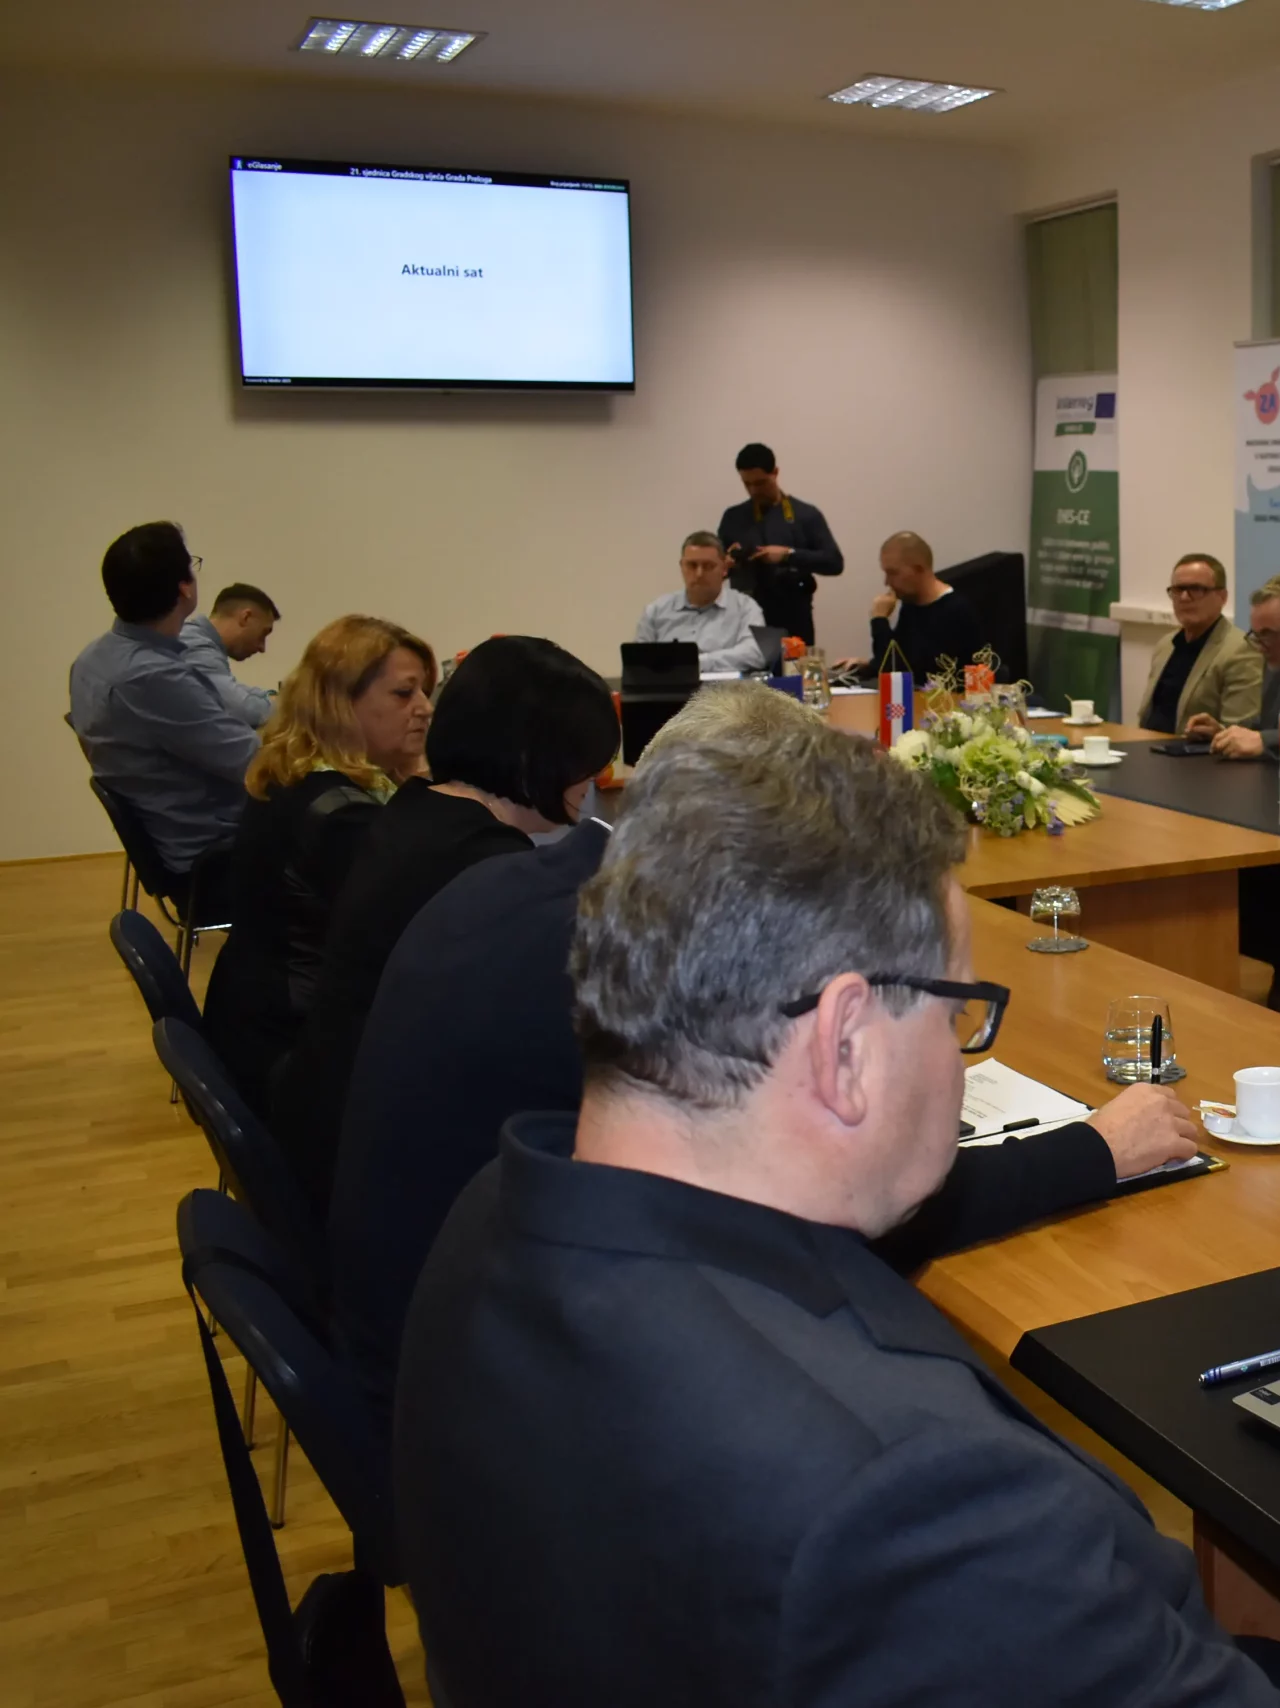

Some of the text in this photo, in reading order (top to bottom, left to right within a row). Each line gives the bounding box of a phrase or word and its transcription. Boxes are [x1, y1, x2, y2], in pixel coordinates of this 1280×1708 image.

[350, 167, 362, 176] 21.
[363, 168, 390, 178] sjednica
[391, 169, 424, 181] Gradskog
[445, 172, 465, 181] Grada
[466, 173, 493, 184] Preloga
[401, 263, 484, 279] Aktualni sat
[1260, 394, 1276, 414] ZA
